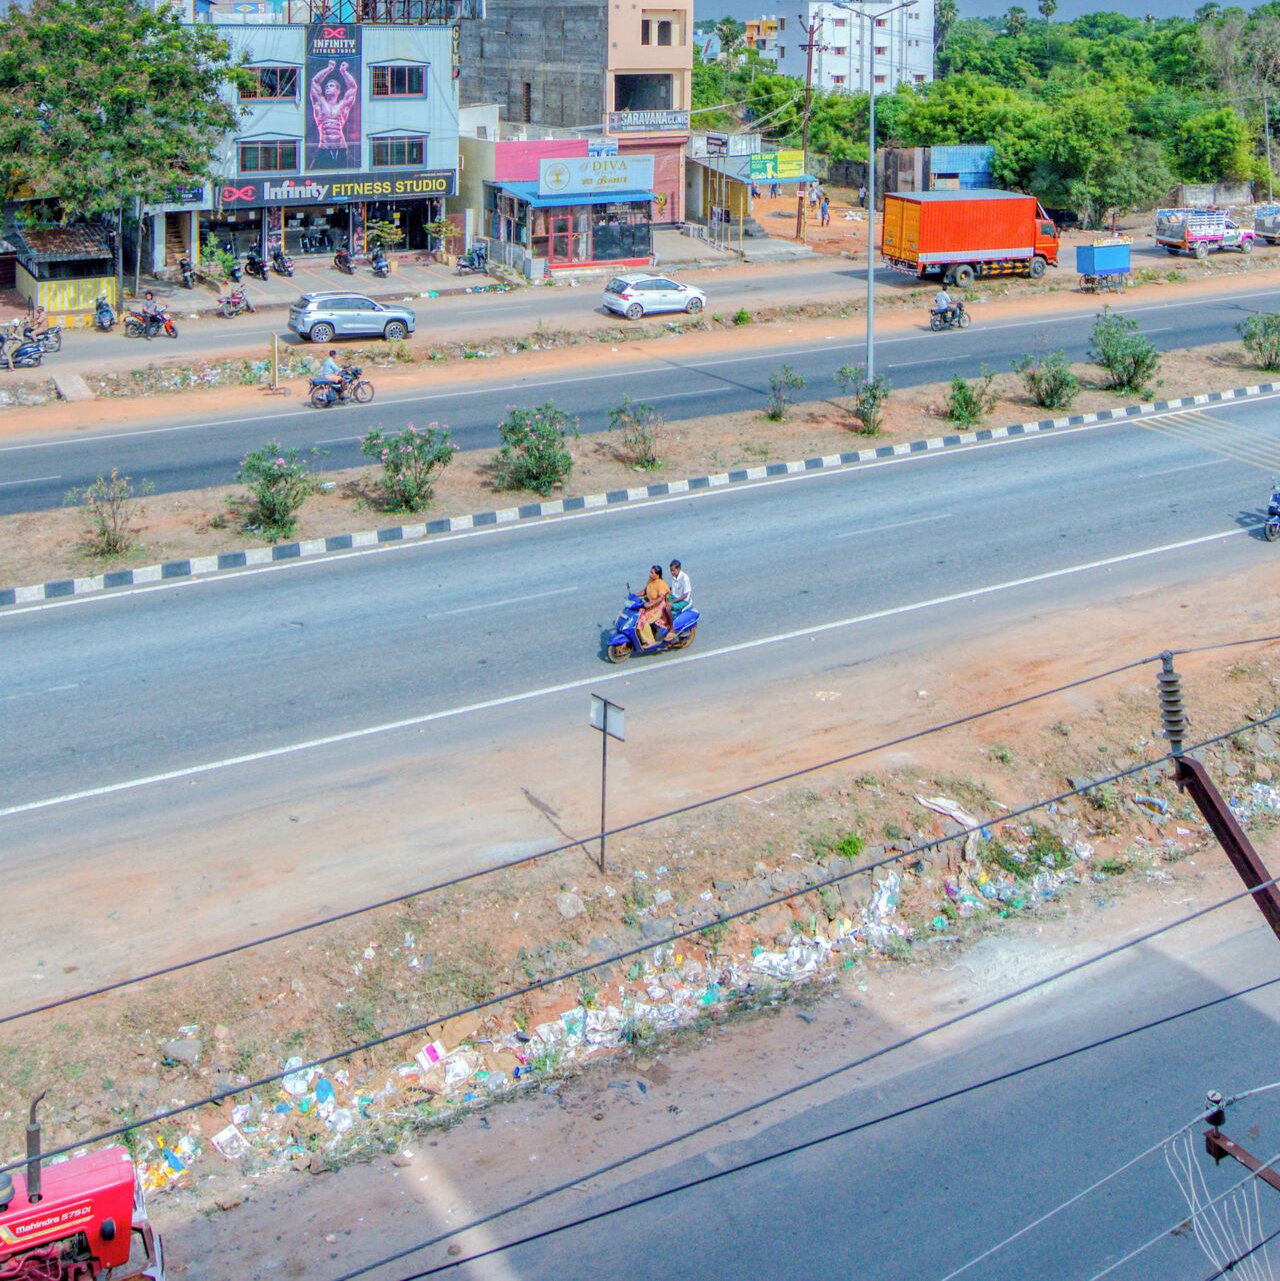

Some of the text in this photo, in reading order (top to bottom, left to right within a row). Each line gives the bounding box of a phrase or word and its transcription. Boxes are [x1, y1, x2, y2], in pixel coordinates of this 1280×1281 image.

[313, 39, 356, 48] INFINITY
[452, 26, 461, 66] GYM
[621, 112, 667, 126] SARAVANA
[592, 159, 628, 172] DIVA
[263, 178, 447, 201] Infinity FITNESS STUDIO
[16, 1216, 60, 1235] Mahindra
